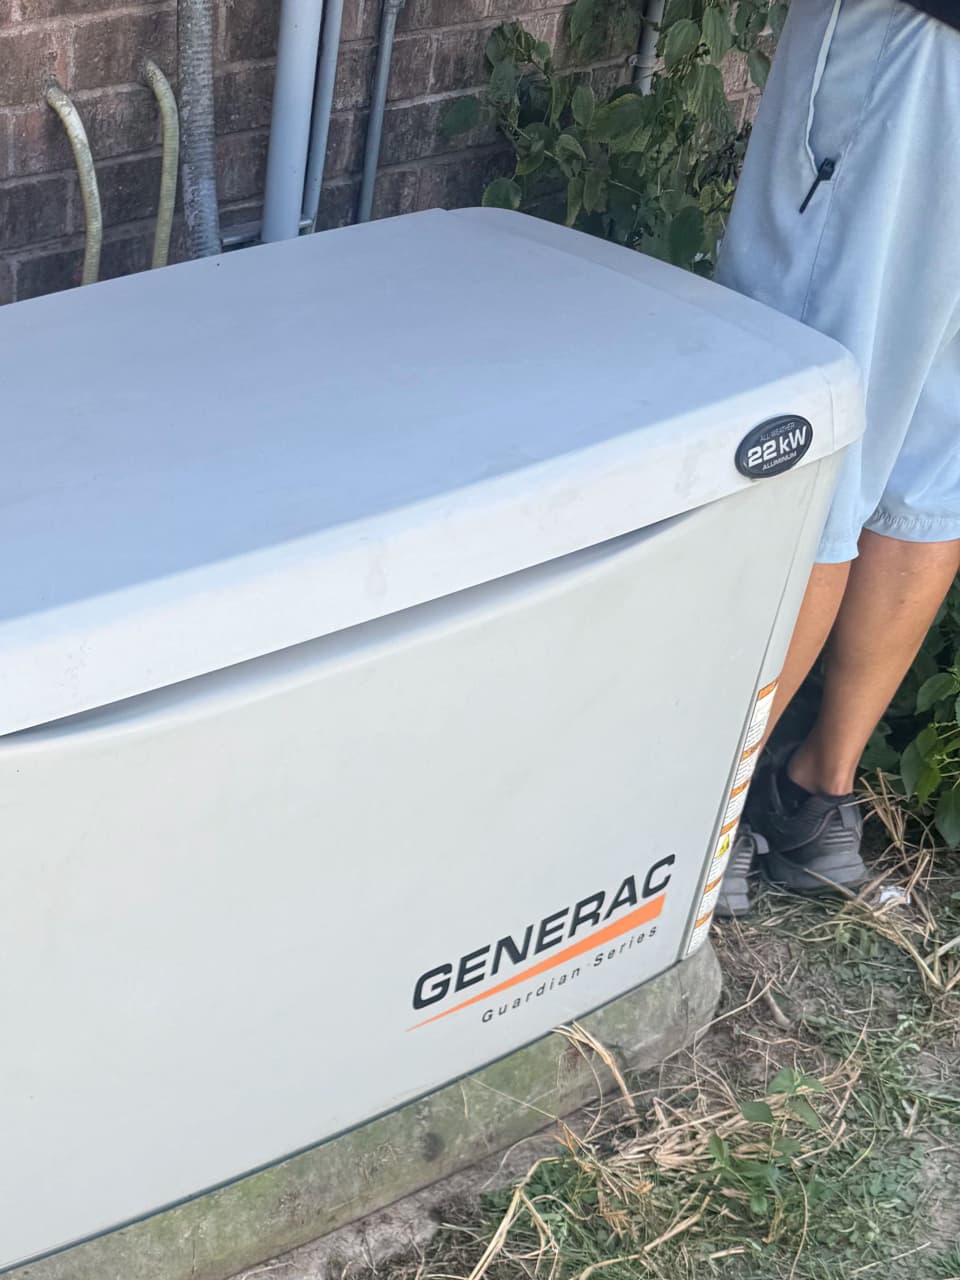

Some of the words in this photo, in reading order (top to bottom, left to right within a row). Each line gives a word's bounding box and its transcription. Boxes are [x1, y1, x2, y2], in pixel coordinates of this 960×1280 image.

[412, 853, 676, 1010] GENERAC
[481, 967, 581, 1023] Guardian
[593, 926, 657, 967] Series
